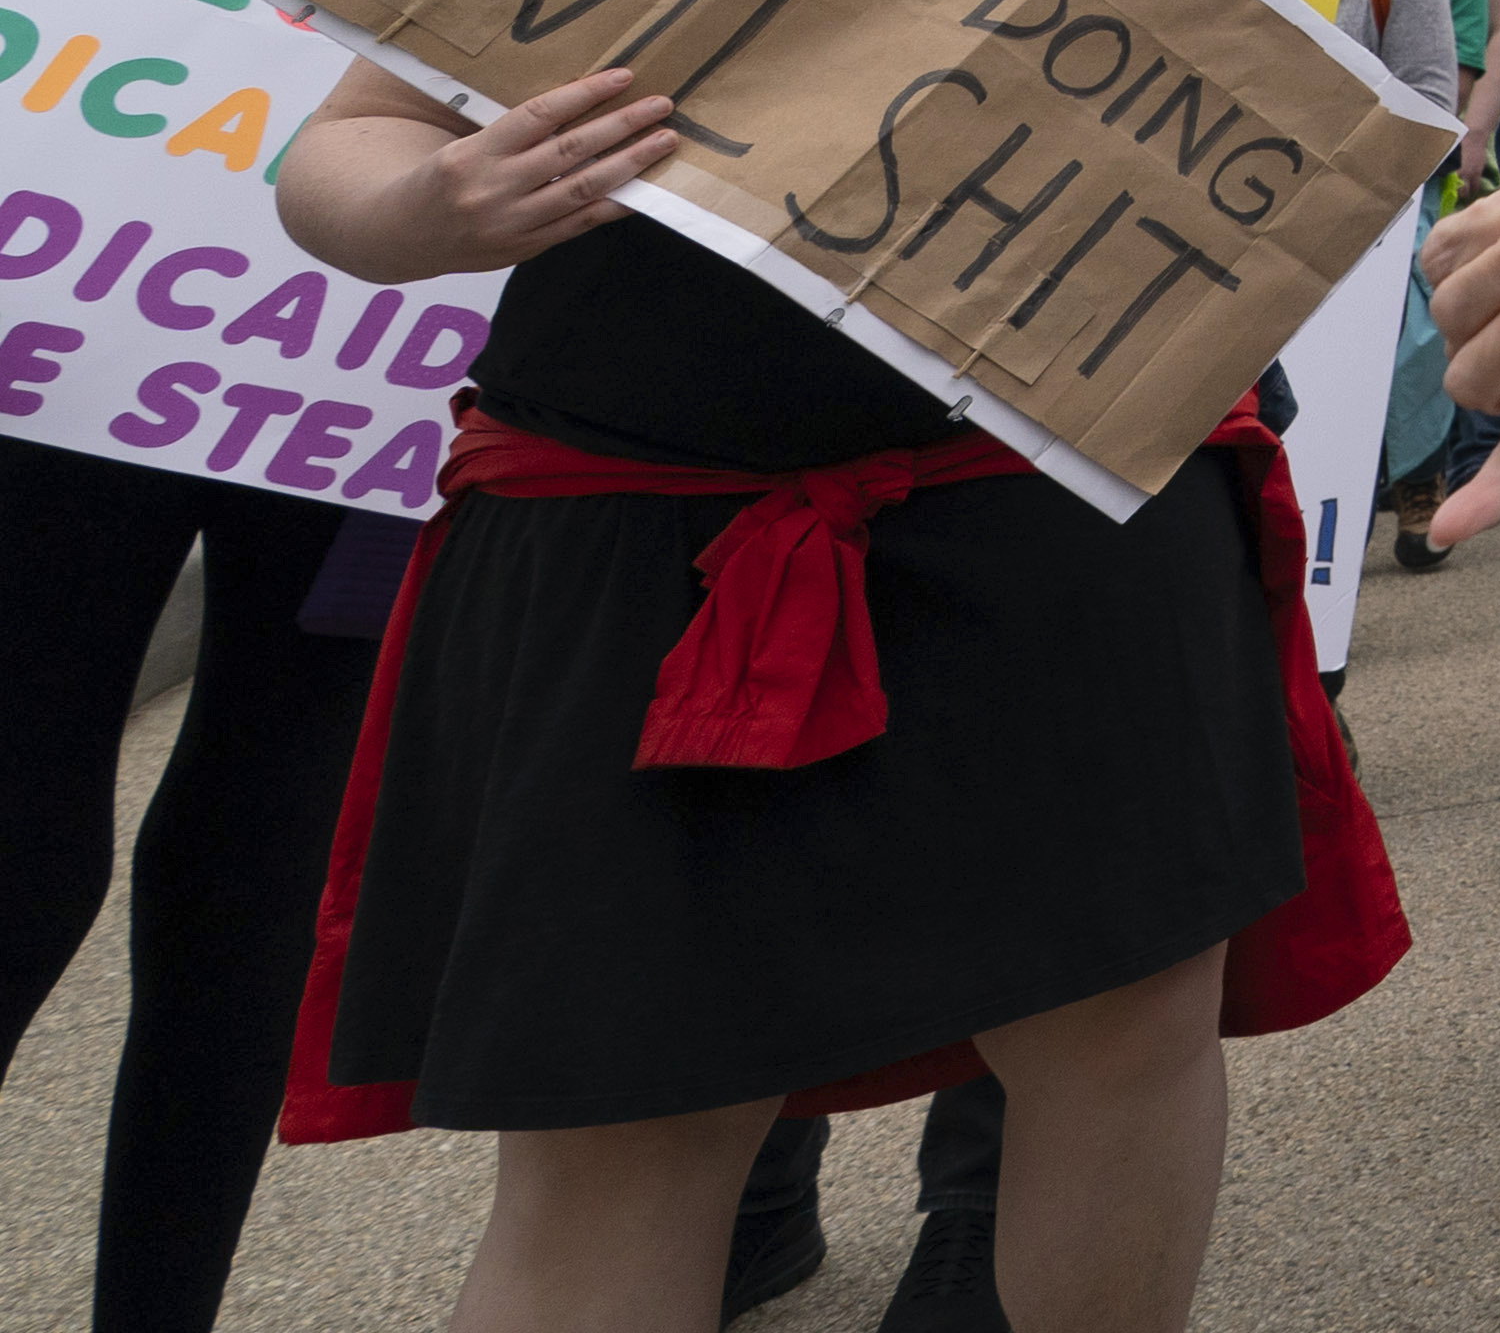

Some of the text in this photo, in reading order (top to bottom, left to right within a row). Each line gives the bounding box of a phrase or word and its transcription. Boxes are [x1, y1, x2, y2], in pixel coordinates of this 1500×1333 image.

[0, 7, 315, 186] ICA
[0, 190, 490, 390] DICAID
[784, 67, 1241, 380] SHIT
[108, 361, 443, 509] STEA
